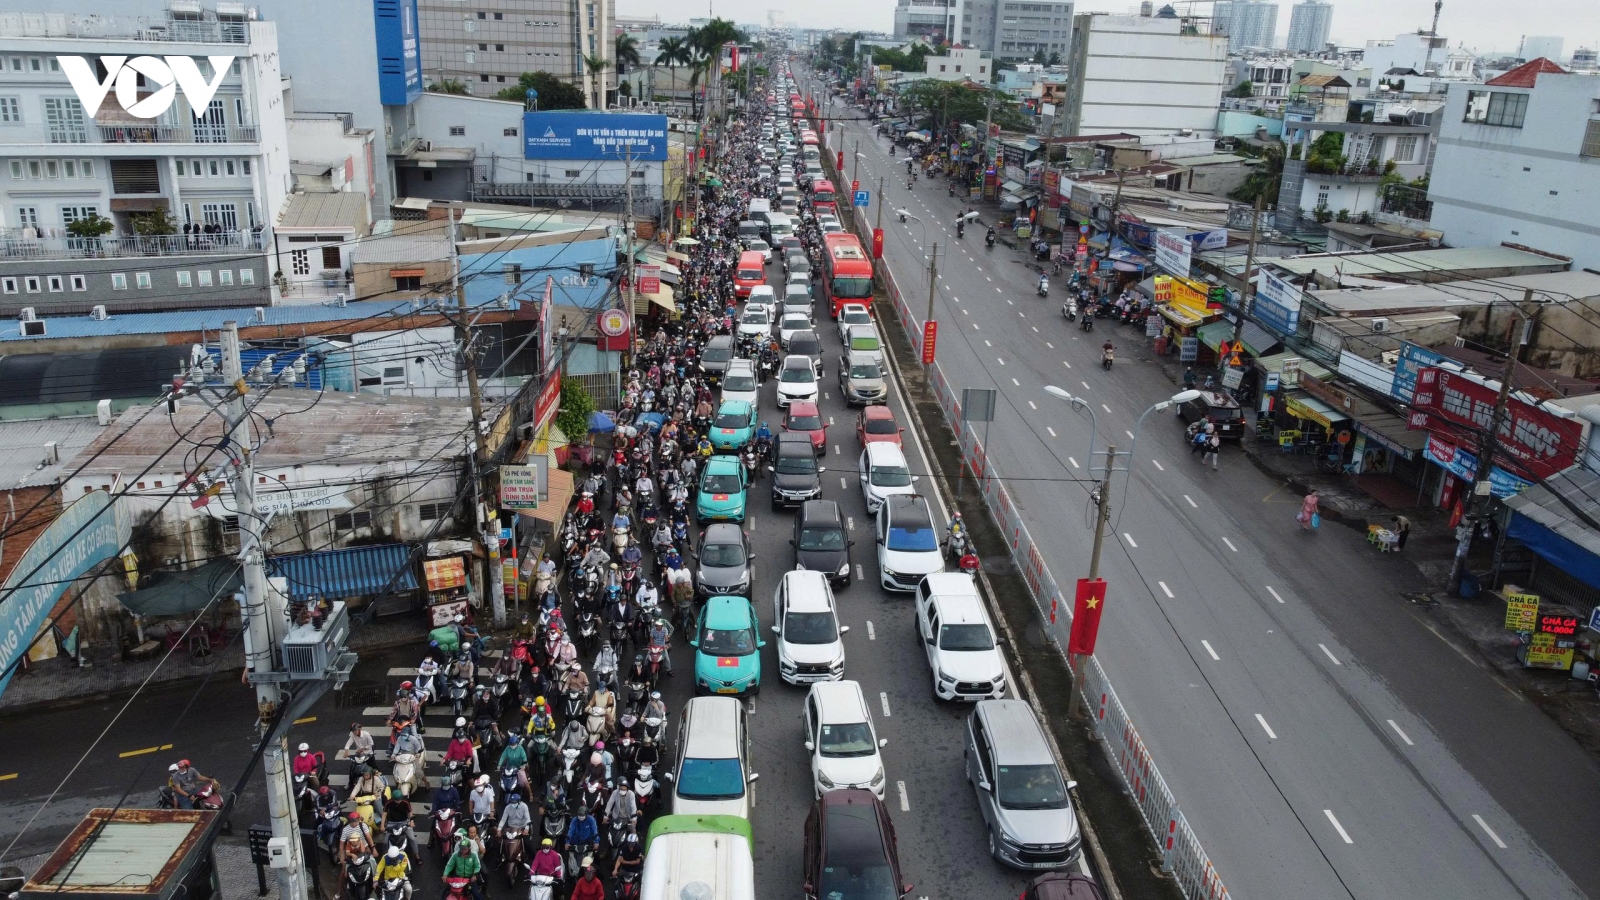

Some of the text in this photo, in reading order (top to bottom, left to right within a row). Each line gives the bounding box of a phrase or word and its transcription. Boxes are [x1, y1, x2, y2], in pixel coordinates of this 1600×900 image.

[1155, 282, 1172, 291] KINH
[609, 318, 621, 329] 15
[1513, 417, 1561, 459] NGỌC
[276, 491, 298, 500] BÌNH
[300, 488, 329, 498] TRIỆU
[272, 500, 288, 511] SỬA
[1509, 595, 1538, 605] CHẢ CÁ
[0, 629, 18, 675] UNG
[14, 603, 36, 637] TÂM
[35, 567, 59, 610] ĐĂNG
[59, 548, 77, 581] KIỂM
[76, 539, 87, 562] XE
[1541, 616, 1577, 628] CHẢ CÁ
